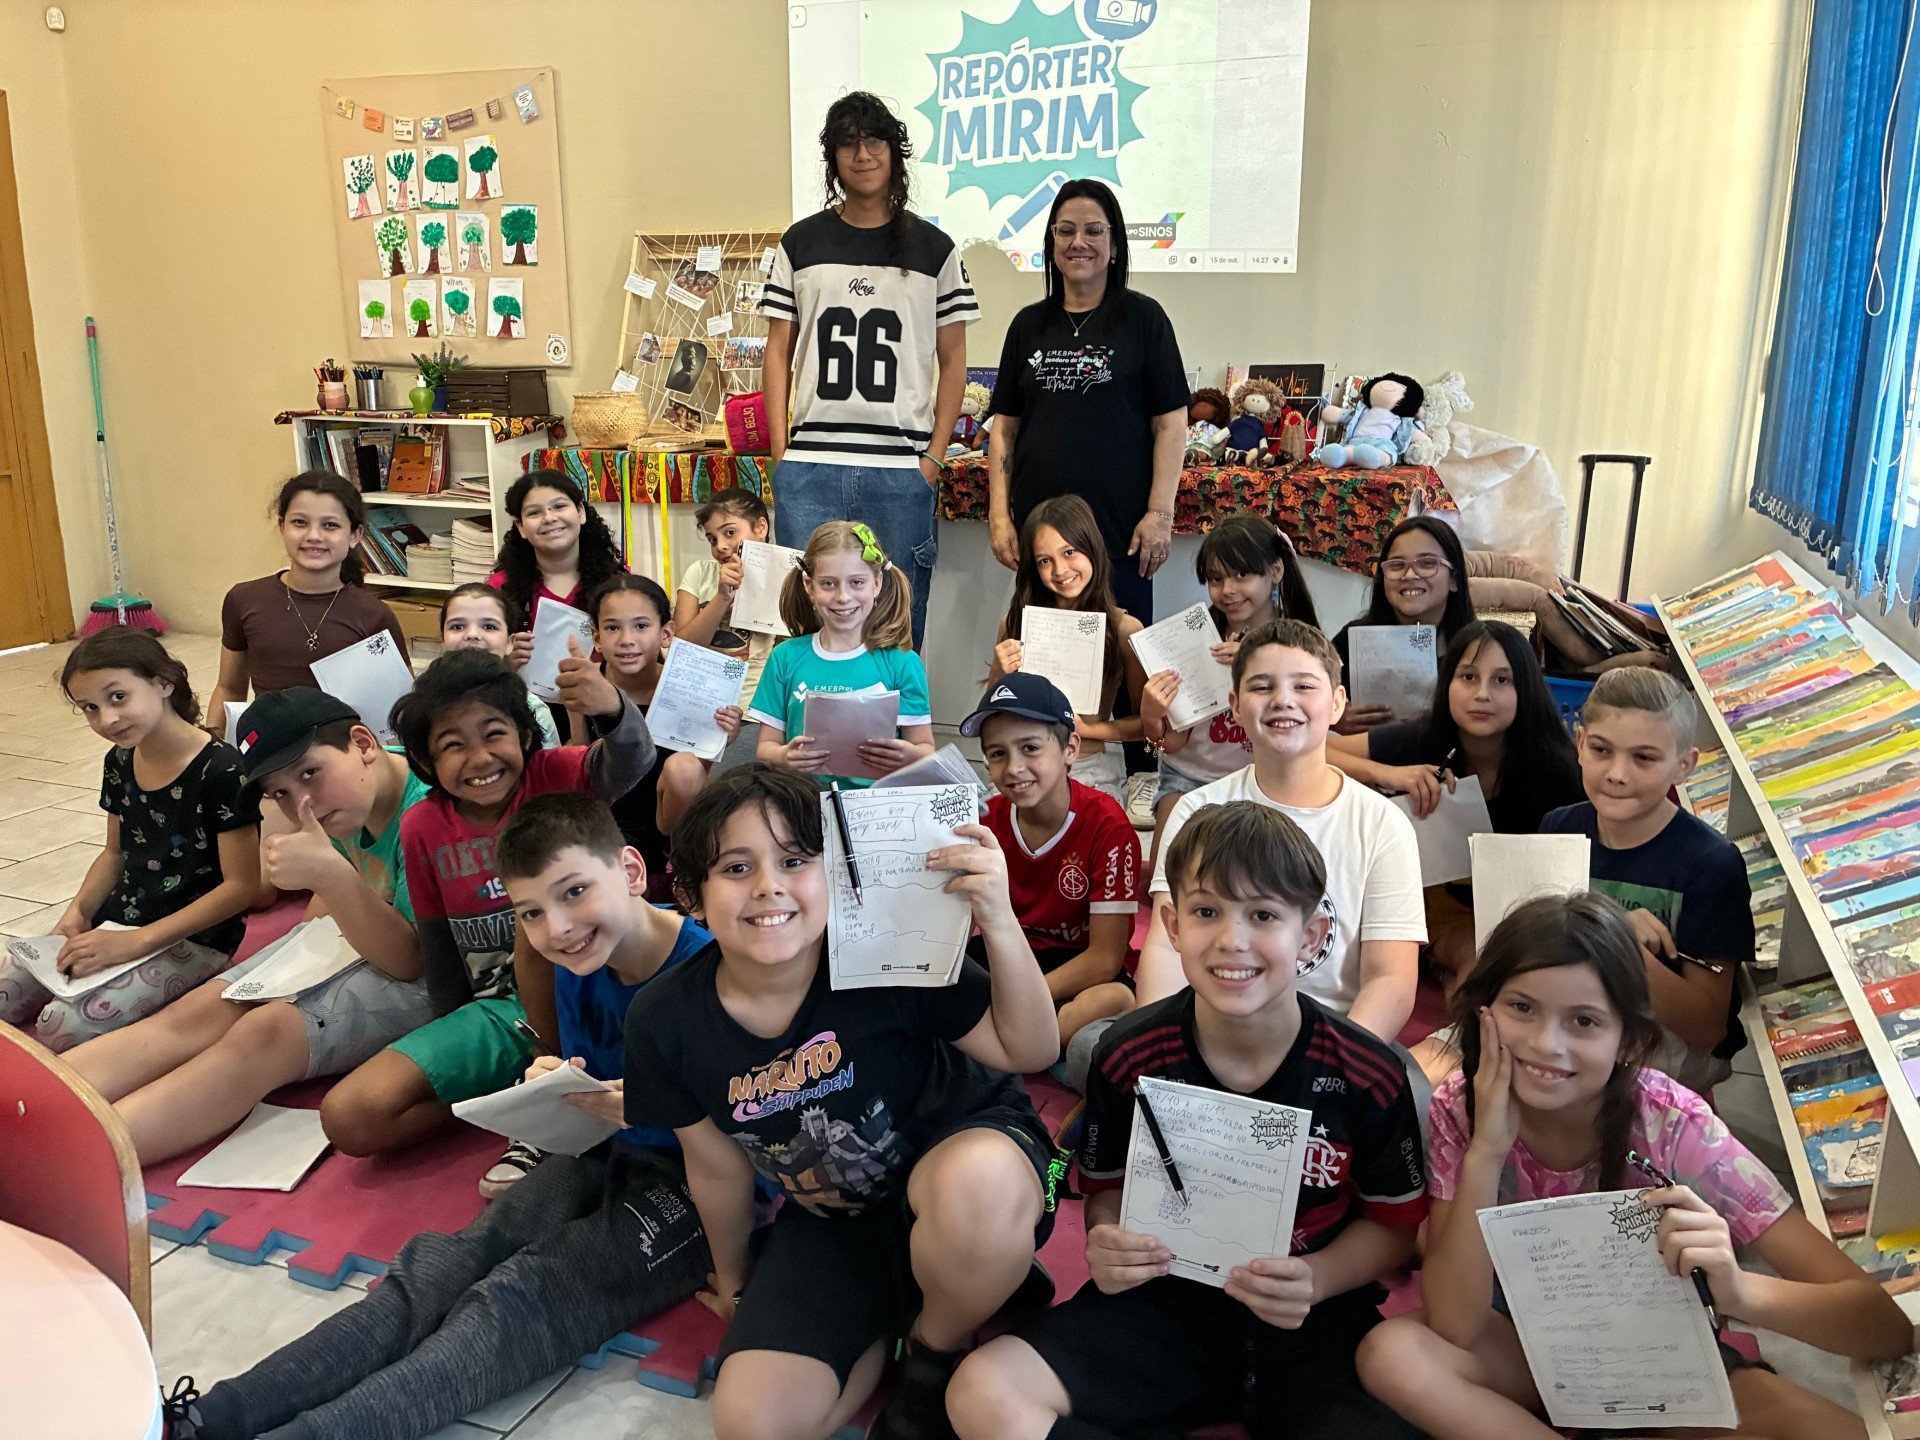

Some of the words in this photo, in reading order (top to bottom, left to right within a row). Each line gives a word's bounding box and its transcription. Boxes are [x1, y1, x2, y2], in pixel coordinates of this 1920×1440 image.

[942, 38, 1111, 100] REPÓRTER
[942, 93, 1116, 165] MIRIM
[1139, 226, 1173, 237] SINOS
[848, 277, 875, 296] King
[816, 306, 903, 403] 66
[937, 801, 967, 817] MIRIM
[728, 1040, 842, 1104] NARUTO
[759, 1061, 854, 1116] SHIPPUDEN
[1257, 1118, 1290, 1127] REPÓRTER
[1257, 1126, 1291, 1137] MIRIM
[668, 1192, 688, 1216] MOST
[1618, 1210, 1659, 1232] MIRIM
